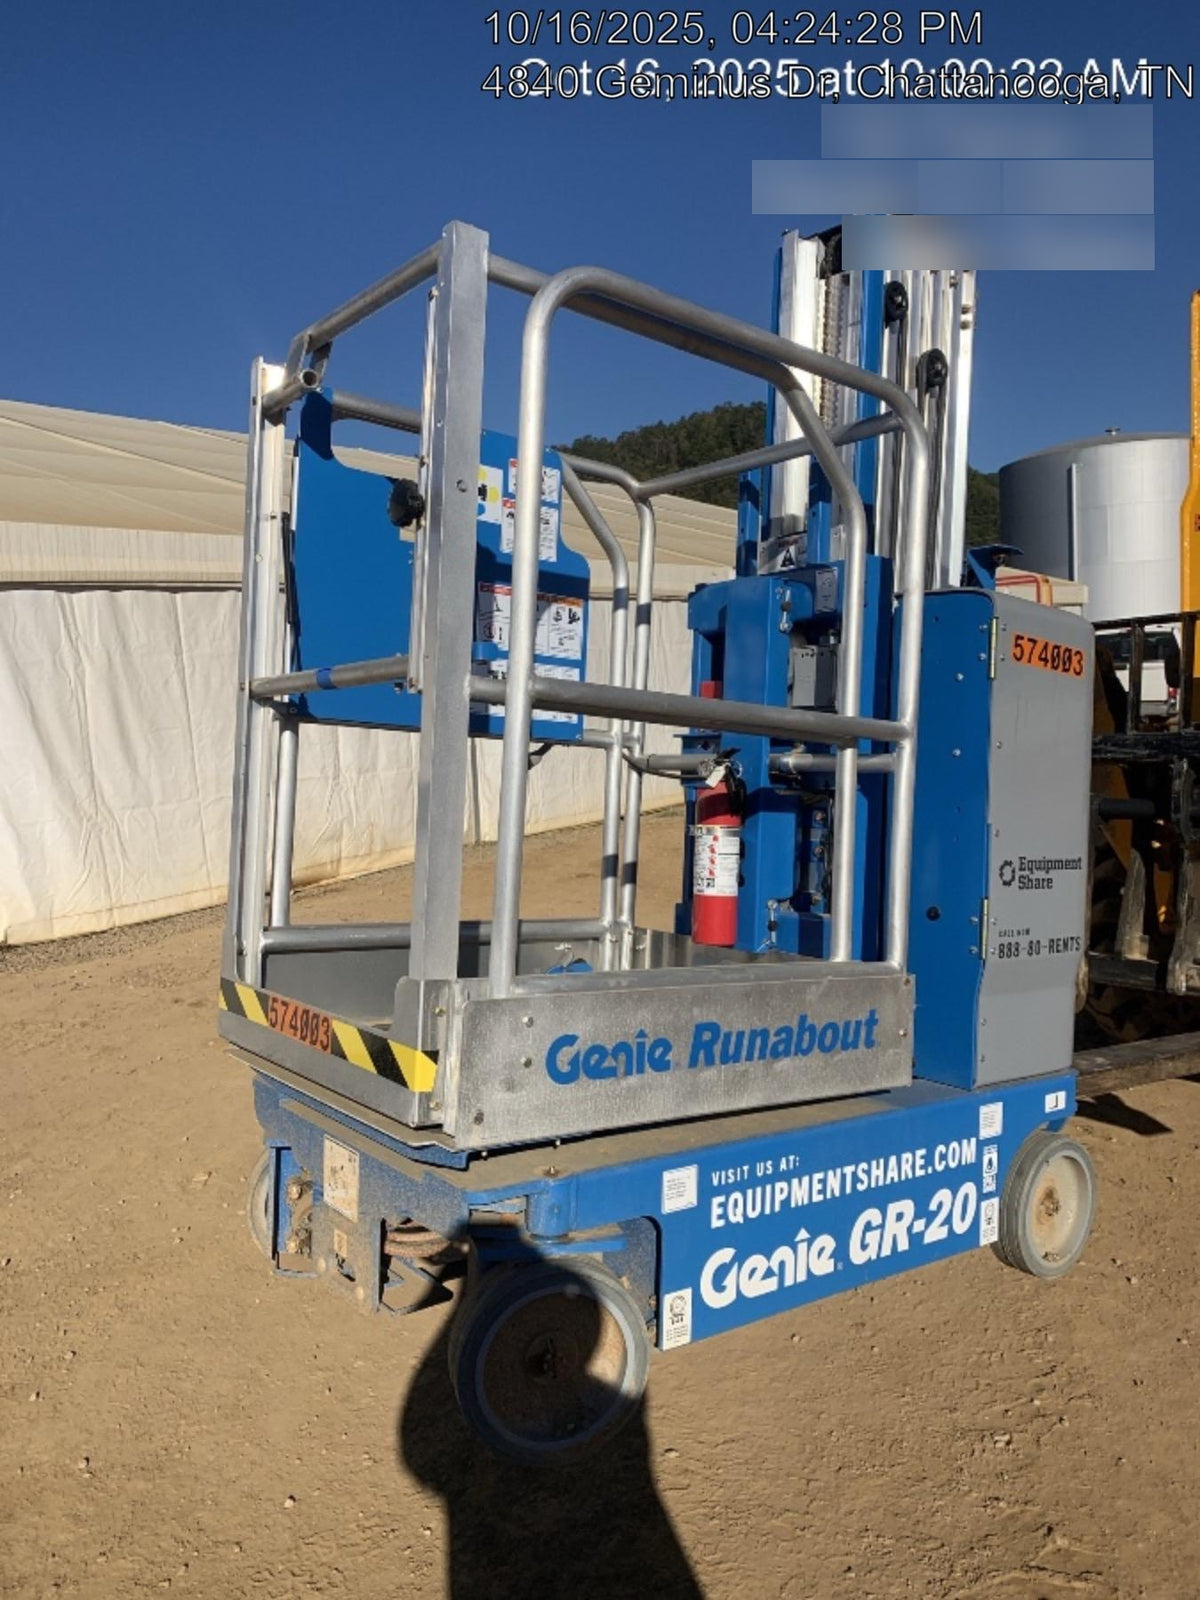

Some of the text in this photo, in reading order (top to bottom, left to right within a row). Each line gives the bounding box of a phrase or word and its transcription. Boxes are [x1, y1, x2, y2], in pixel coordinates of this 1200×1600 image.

[1012, 633, 1084, 676] 574003
[1018, 856, 1083, 875] Equipment
[1018, 874, 1053, 890] Share
[269, 996, 331, 1052] 574003
[545, 1008, 879, 1086] Genie Runabout
[710, 1137, 978, 1230] EQUIPMENTSHARE.COM
[711, 1154, 800, 1187] VISIT US AT:
[700, 1226, 838, 1310] Genie
[848, 1180, 978, 1266] GR-20
